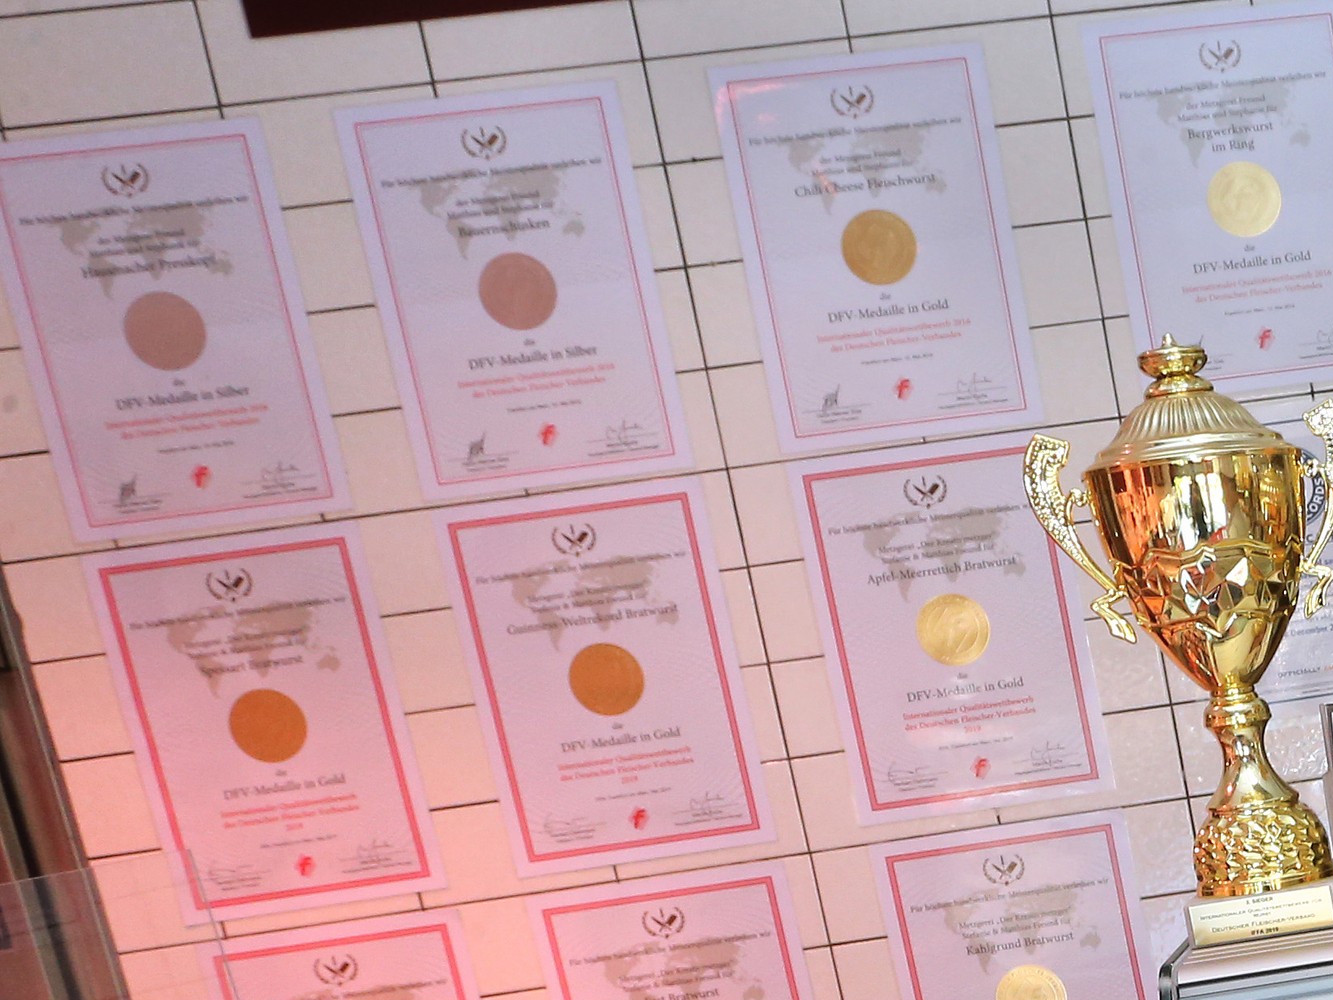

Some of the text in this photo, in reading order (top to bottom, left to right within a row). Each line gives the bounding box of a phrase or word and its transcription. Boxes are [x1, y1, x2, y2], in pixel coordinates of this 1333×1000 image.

[1193, 256, 1267, 275] DFV-Medaille
[1285, 250, 1311, 263] Gold
[922, 299, 949, 311] Gold
[965, 557, 1017, 571] Bratwurst
[998, 677, 1024, 689] Gold
[966, 932, 1074, 956] Kahlgrund Bratwurst
